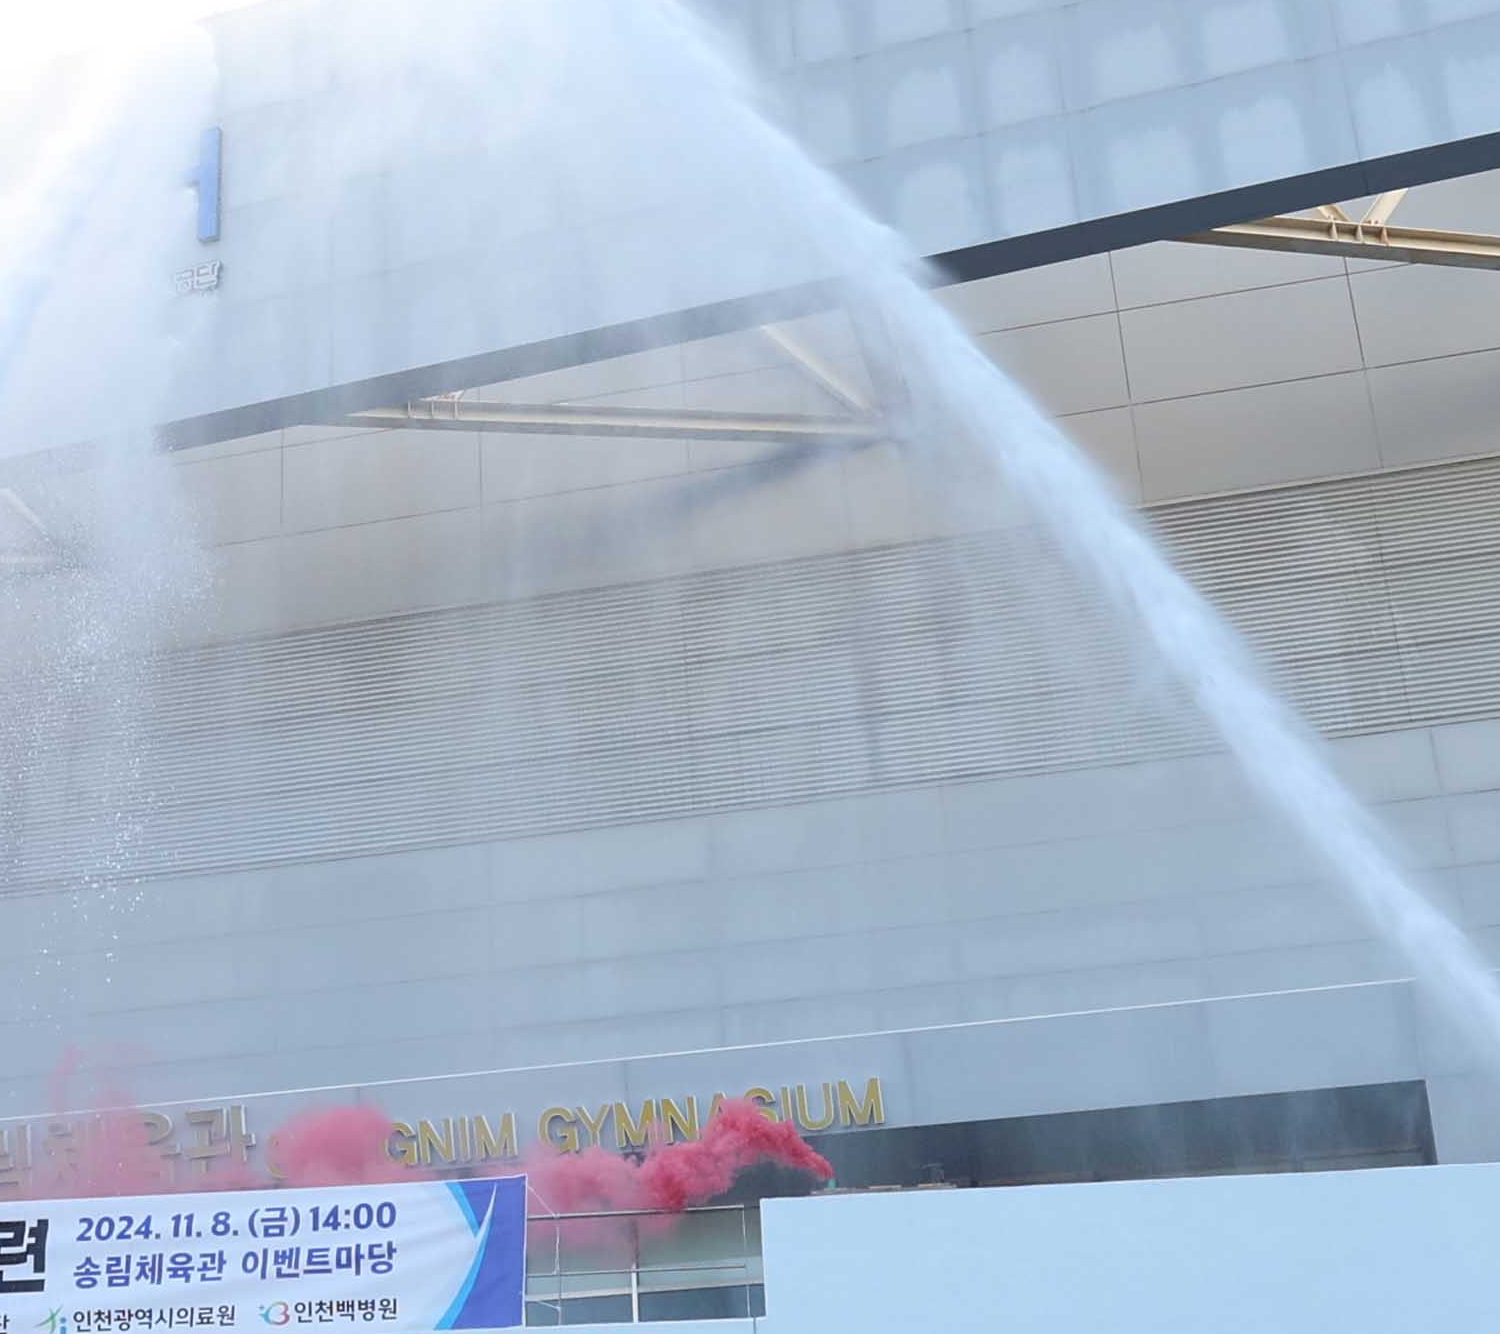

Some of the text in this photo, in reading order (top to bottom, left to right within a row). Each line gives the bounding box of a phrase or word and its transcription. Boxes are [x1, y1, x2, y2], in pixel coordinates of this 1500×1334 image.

[75, 1201, 397, 1242] 2024. 11. 8. (금) 14:00
[73, 1240, 398, 1290] 송림체육관 이벤트마당
[72, 1305, 236, 1333] 인천광역시의료원
[293, 1298, 398, 1324] 인천백병원
